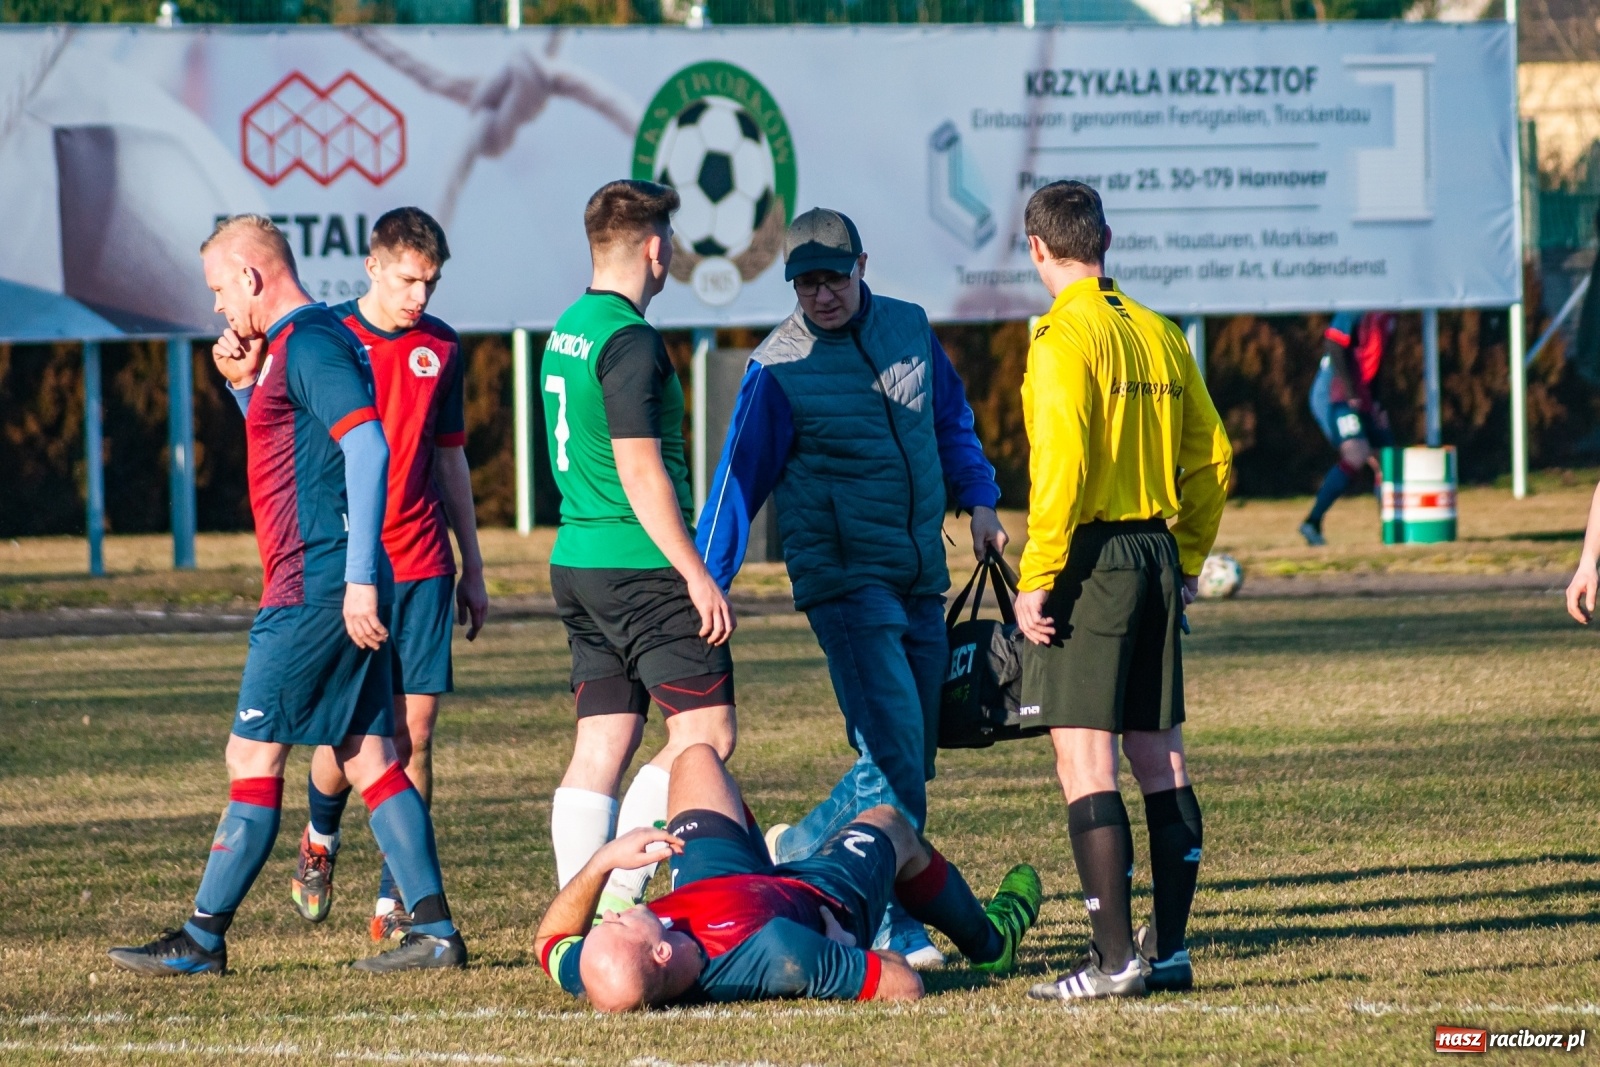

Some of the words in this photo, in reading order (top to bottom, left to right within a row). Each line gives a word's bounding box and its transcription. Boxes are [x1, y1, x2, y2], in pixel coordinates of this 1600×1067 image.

[1168, 65, 1319, 95] KRZYSZTOF
[1239, 168, 1328, 189] Hannover
[545, 374, 570, 472] 7
[949, 642, 977, 681] ECT
